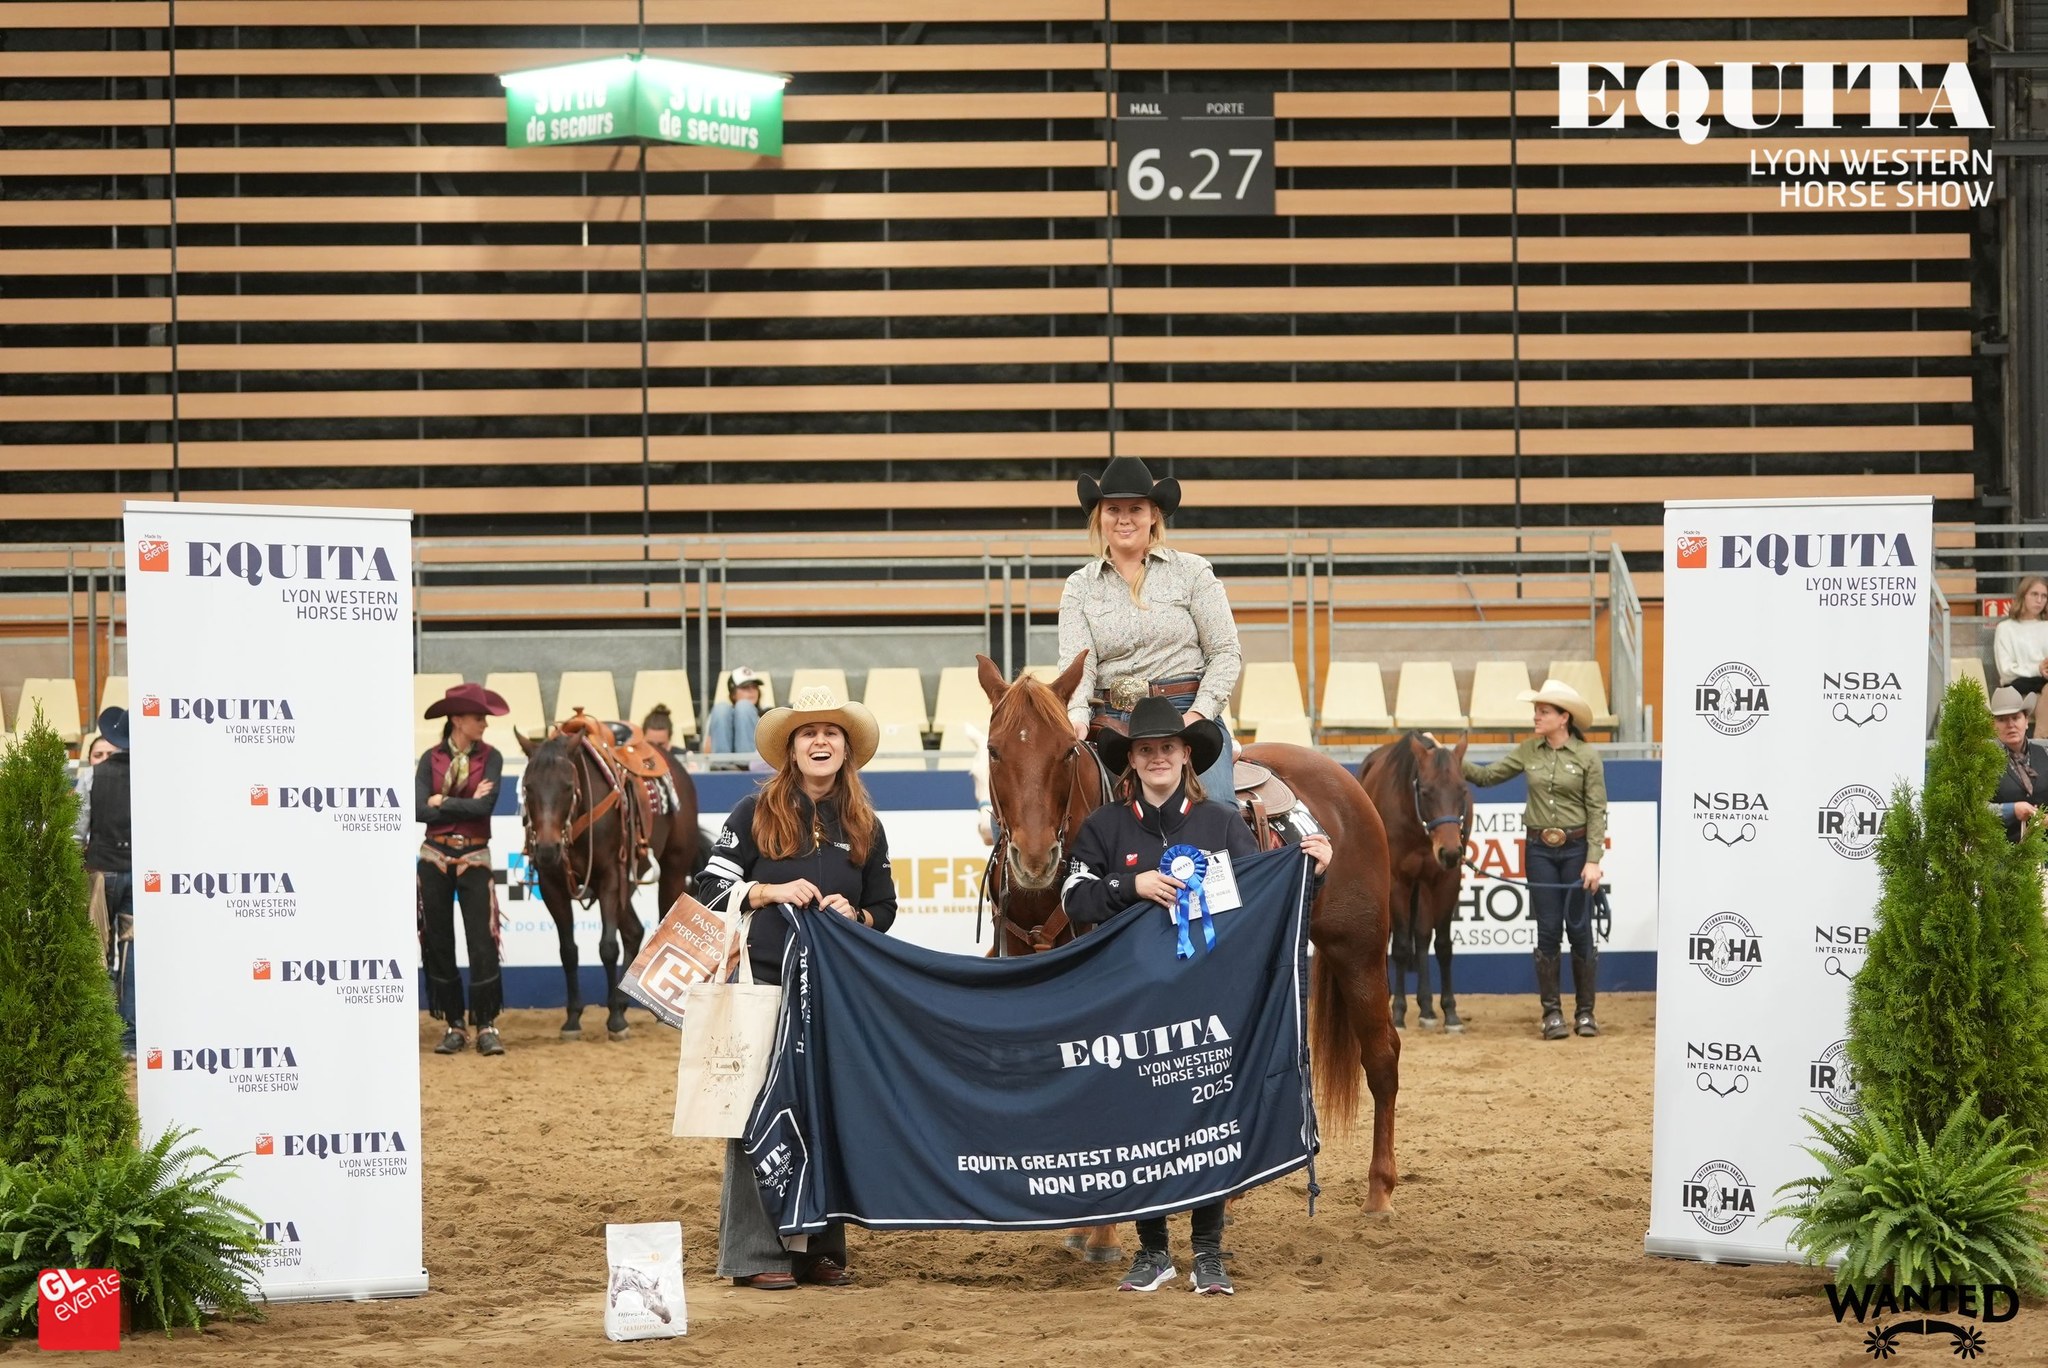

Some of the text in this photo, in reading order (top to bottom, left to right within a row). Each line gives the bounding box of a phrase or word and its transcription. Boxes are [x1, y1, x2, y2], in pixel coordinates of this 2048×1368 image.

[1130, 102, 1162, 114] HALL
[1206, 102, 1244, 114] PORTE
[526, 112, 614, 144] de secours
[658, 108, 758, 150] de secours
[1128, 148, 1263, 200] 6.27
[1677, 537, 1695, 549] GL
[1718, 533, 1918, 576] EQUITA
[185, 541, 399, 586] EQUITA
[1806, 577, 1916, 591] LYON WESTERN
[282, 589, 398, 604] LYON WESTERN
[1819, 593, 1916, 606] HORSE SHOW
[297, 606, 398, 621] HORSE SHOW
[1710, 665, 1743, 682] INTERNATIONAL
[1823, 672, 1902, 690] NSBA
[1696, 689, 1769, 711] IRHA
[168, 698, 295, 724] EQUITA
[225, 725, 295, 734] LYON WESTERN
[1725, 718, 1754, 733] ASSOCIATION
[234, 735, 295, 744] HORSE SHOW
[277, 787, 401, 812] EQUITA
[1693, 792, 1769, 811] NSBA
[333, 813, 401, 822] LYON WESTERN
[1693, 813, 1769, 821] INTERNATIONAL
[342, 823, 401, 832] HORSE SHOW
[169, 872, 296, 899] EQUITA
[226, 899, 296, 908] LYON WESTERN
[918, 905, 938, 913] LES
[235, 908, 296, 918] HORSE SHOW
[515, 922, 535, 931] DO
[691, 913, 726, 942] PASSIO
[1816, 925, 1870, 944] NSB
[672, 921, 723, 962] PERFECTIO
[1689, 937, 1762, 962] IRHA
[280, 959, 404, 986] EQUITA
[1719, 969, 1747, 983] ASSOCIATION
[336, 985, 404, 994] LYON WESTERN
[345, 995, 404, 1004] HORSE SHOW
[1057, 1014, 1233, 1069] EQUITA
[1687, 1041, 1762, 1062] NSBA
[171, 1047, 298, 1074] EQUITA
[1138, 1046, 1233, 1077] LYON WESTERN
[1687, 1063, 1762, 1073] INTERNATIONAL
[229, 1073, 299, 1084] LYON WESTERN
[1152, 1058, 1233, 1087] HORSE SHOW
[238, 1082, 299, 1093] HORSE SHOW
[1192, 1075, 1234, 1104] 2025
[282, 1131, 407, 1159] EQUITA
[958, 1120, 1240, 1174] EQUITA GREATEST RANCH HORSE
[339, 1157, 407, 1168] LYON WESTERN
[1029, 1141, 1242, 1196] NON PRO CHAMPION
[347, 1167, 407, 1178] HORSE SHOW
[1683, 1185, 1755, 1212] IRHA
[274, 1258, 302, 1267] SHOW
